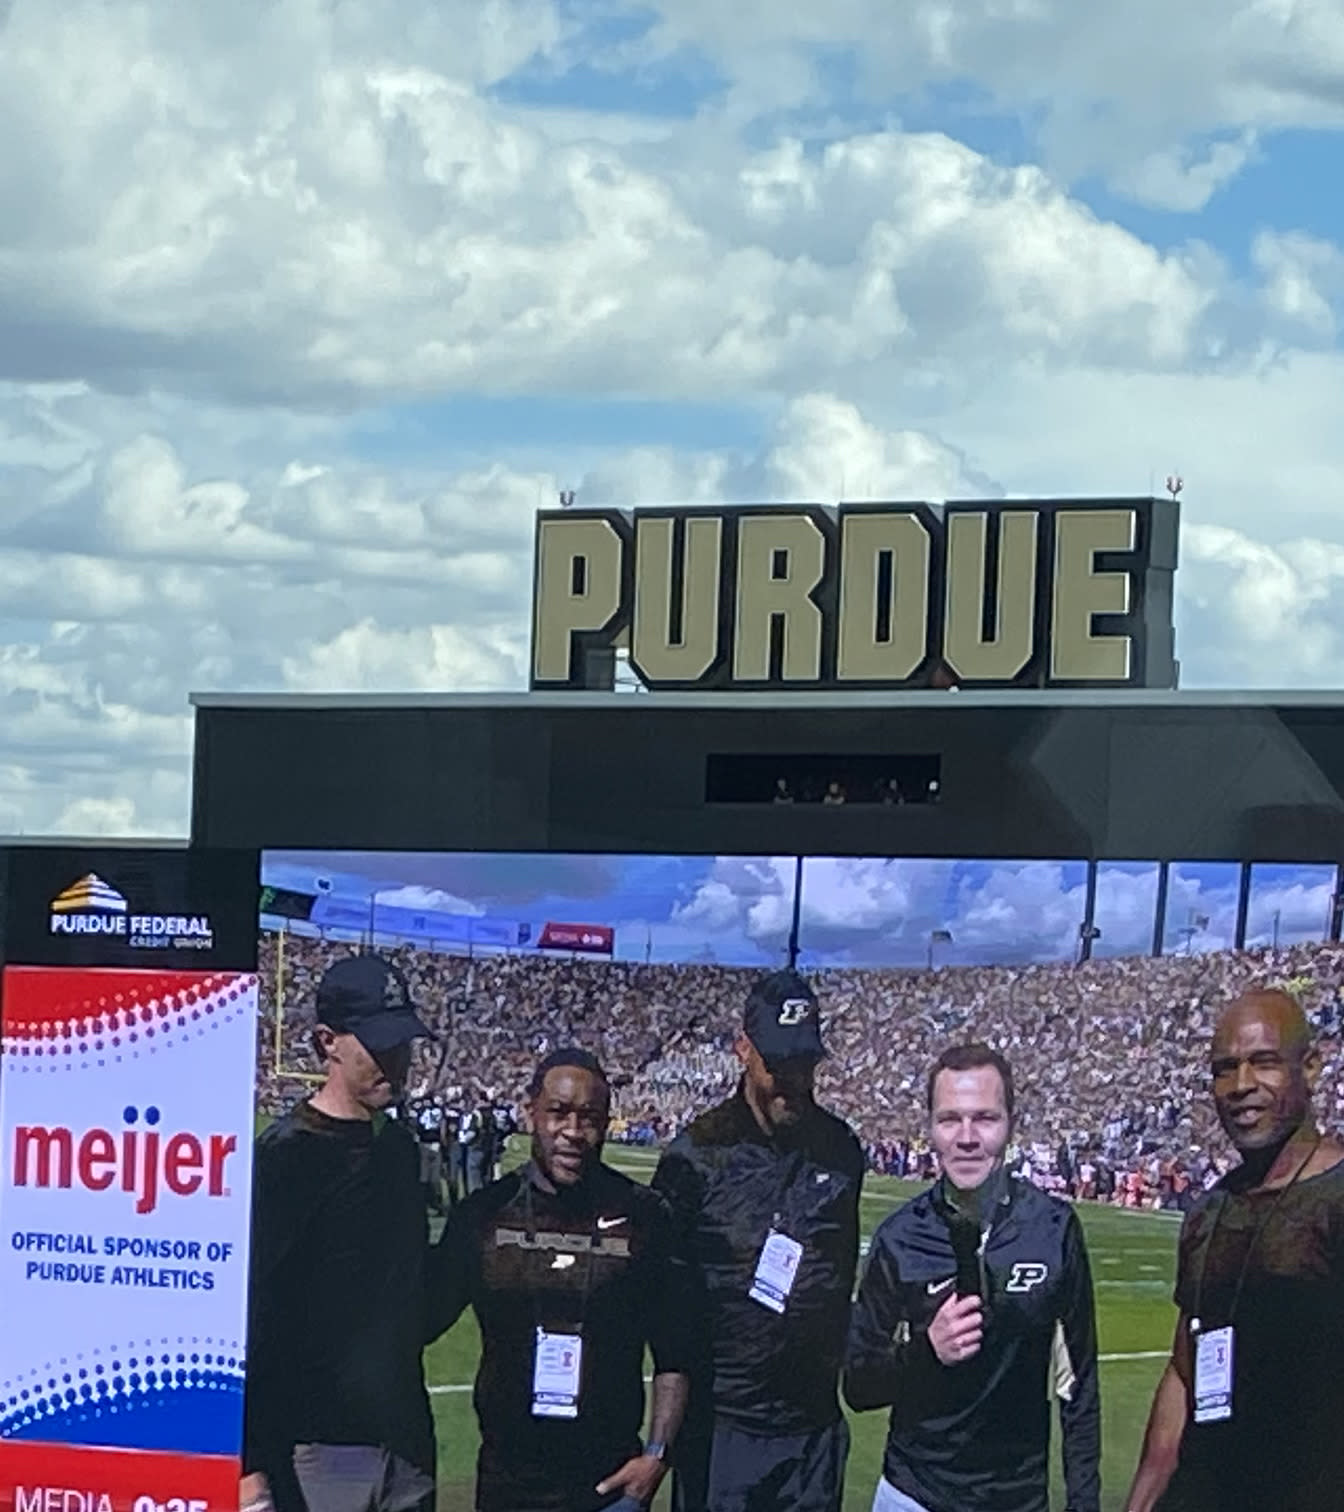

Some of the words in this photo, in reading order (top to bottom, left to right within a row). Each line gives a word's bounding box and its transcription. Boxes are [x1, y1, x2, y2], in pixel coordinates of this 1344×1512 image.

[535, 510, 1137, 681] PURDUE
[51, 914, 126, 934] PURDUE
[129, 916, 212, 936] FEDERAL
[14, 1106, 236, 1214] meijer
[11, 1231, 96, 1255] OFFICIAL
[103, 1236, 201, 1261] SPONSOR
[206, 1242, 233, 1263] OF
[26, 1262, 106, 1284] PURDUE
[110, 1267, 215, 1291] ATHLETICS
[1006, 1263, 1048, 1292] P
